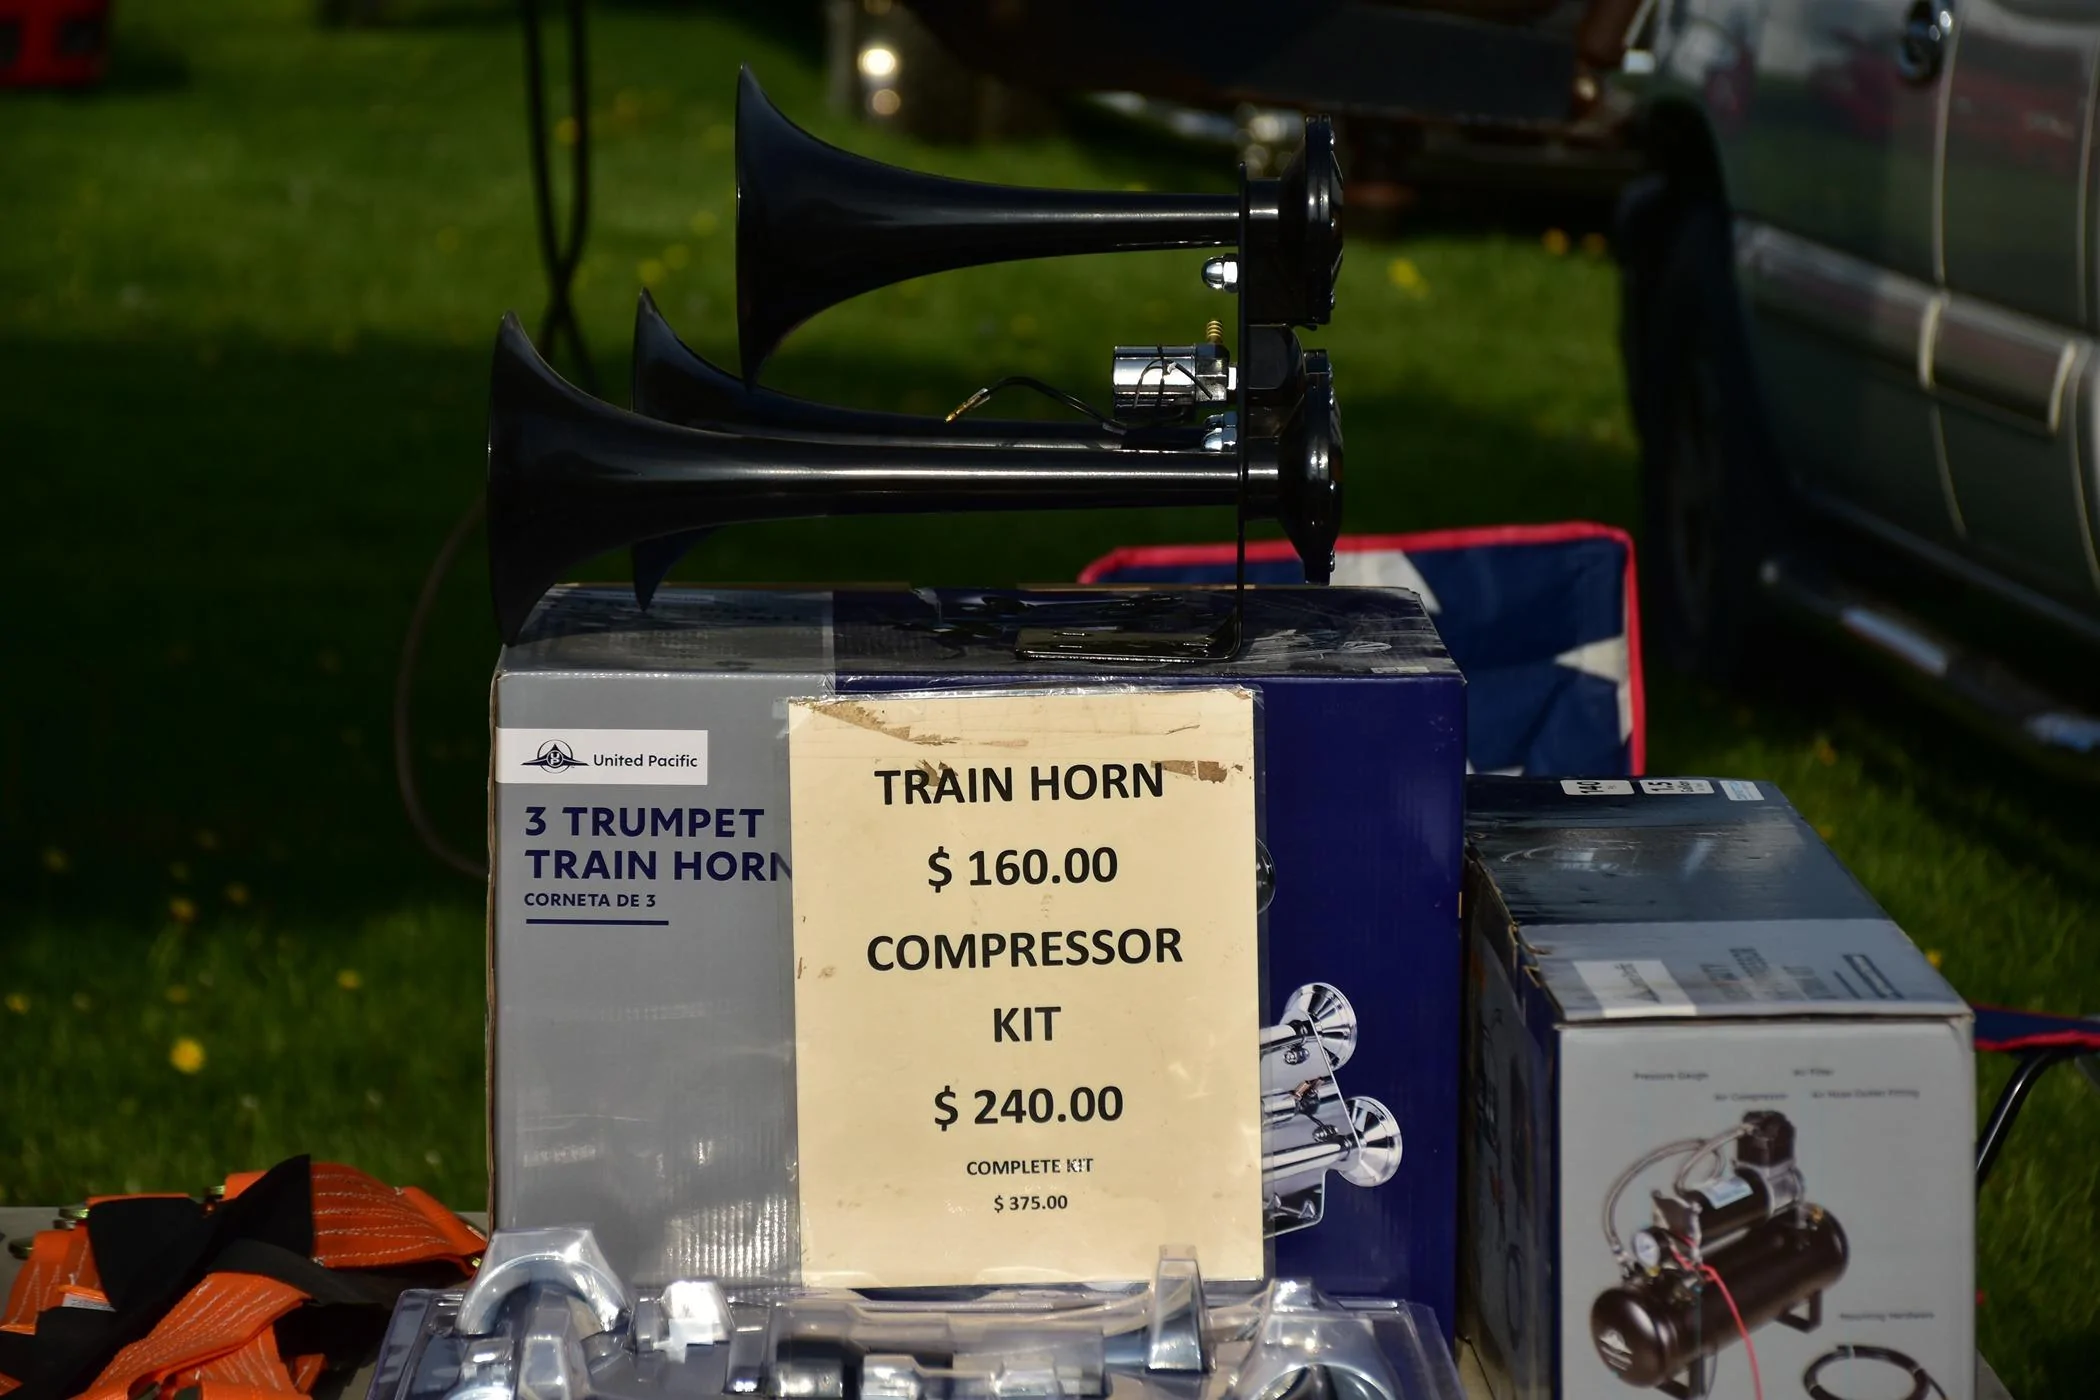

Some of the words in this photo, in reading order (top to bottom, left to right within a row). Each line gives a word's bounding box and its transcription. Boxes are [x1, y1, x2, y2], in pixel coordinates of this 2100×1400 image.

[593, 754, 644, 767] United
[648, 754, 698, 768] Pacific
[874, 763, 1013, 806] TRAIN
[1031, 762, 1165, 801] HORN
[525, 806, 547, 837] 3
[561, 806, 765, 838] TRUMPET
[524, 849, 657, 880] TRAIN
[928, 846, 953, 894] $
[969, 846, 1118, 886] 160.00
[524, 892, 611, 908] CORNETA
[616, 893, 640, 908] DE
[645, 894, 656, 908] 3
[867, 927, 1183, 972] COMPRESSOR
[993, 1006, 1062, 1043] KIT
[934, 1085, 959, 1132] $
[974, 1085, 1124, 1125] 240.00
[966, 1159, 1061, 1176] COMPLETE
[1066, 1158, 1094, 1173] KIT
[994, 1194, 1004, 1214] $
[1009, 1194, 1068, 1212] 375.00
